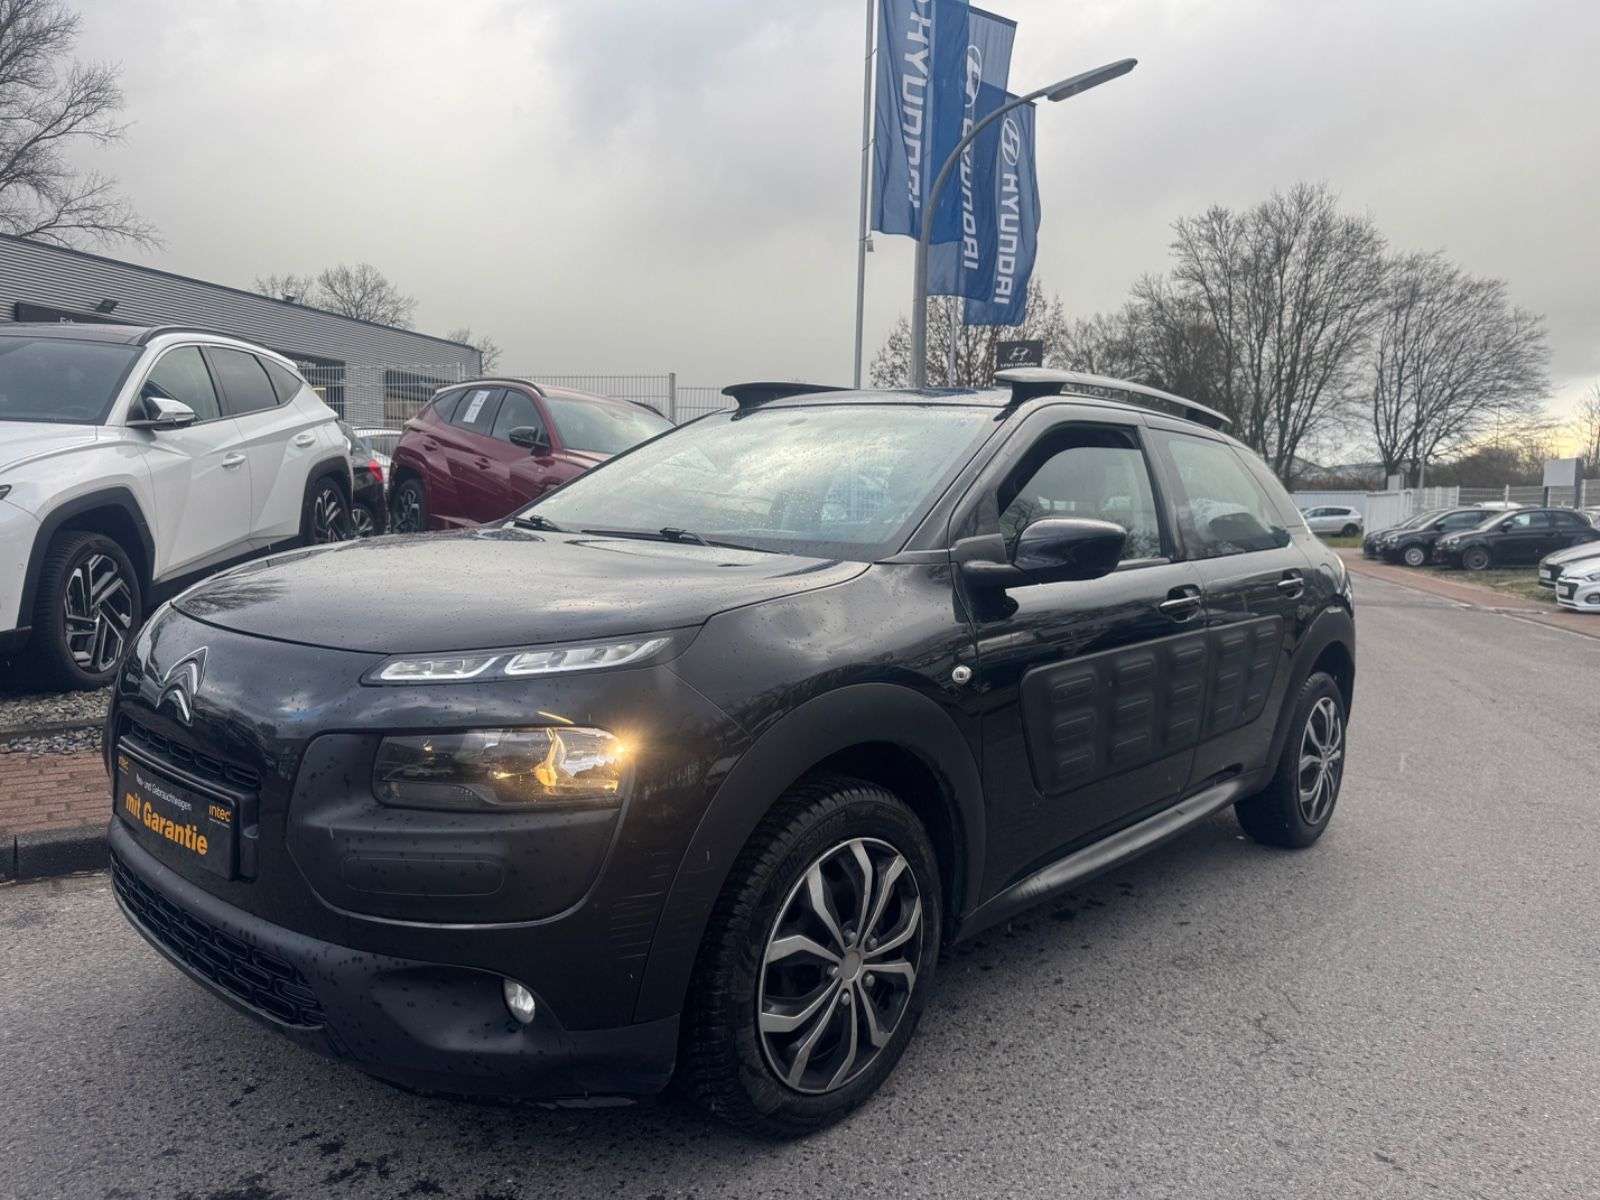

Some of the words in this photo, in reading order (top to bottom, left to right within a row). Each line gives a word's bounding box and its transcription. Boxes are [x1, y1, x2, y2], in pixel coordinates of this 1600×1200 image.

[993, 173, 1020, 305] HYUNDAI
[126, 792, 141, 821] mit
[143, 801, 209, 856] Garantie
